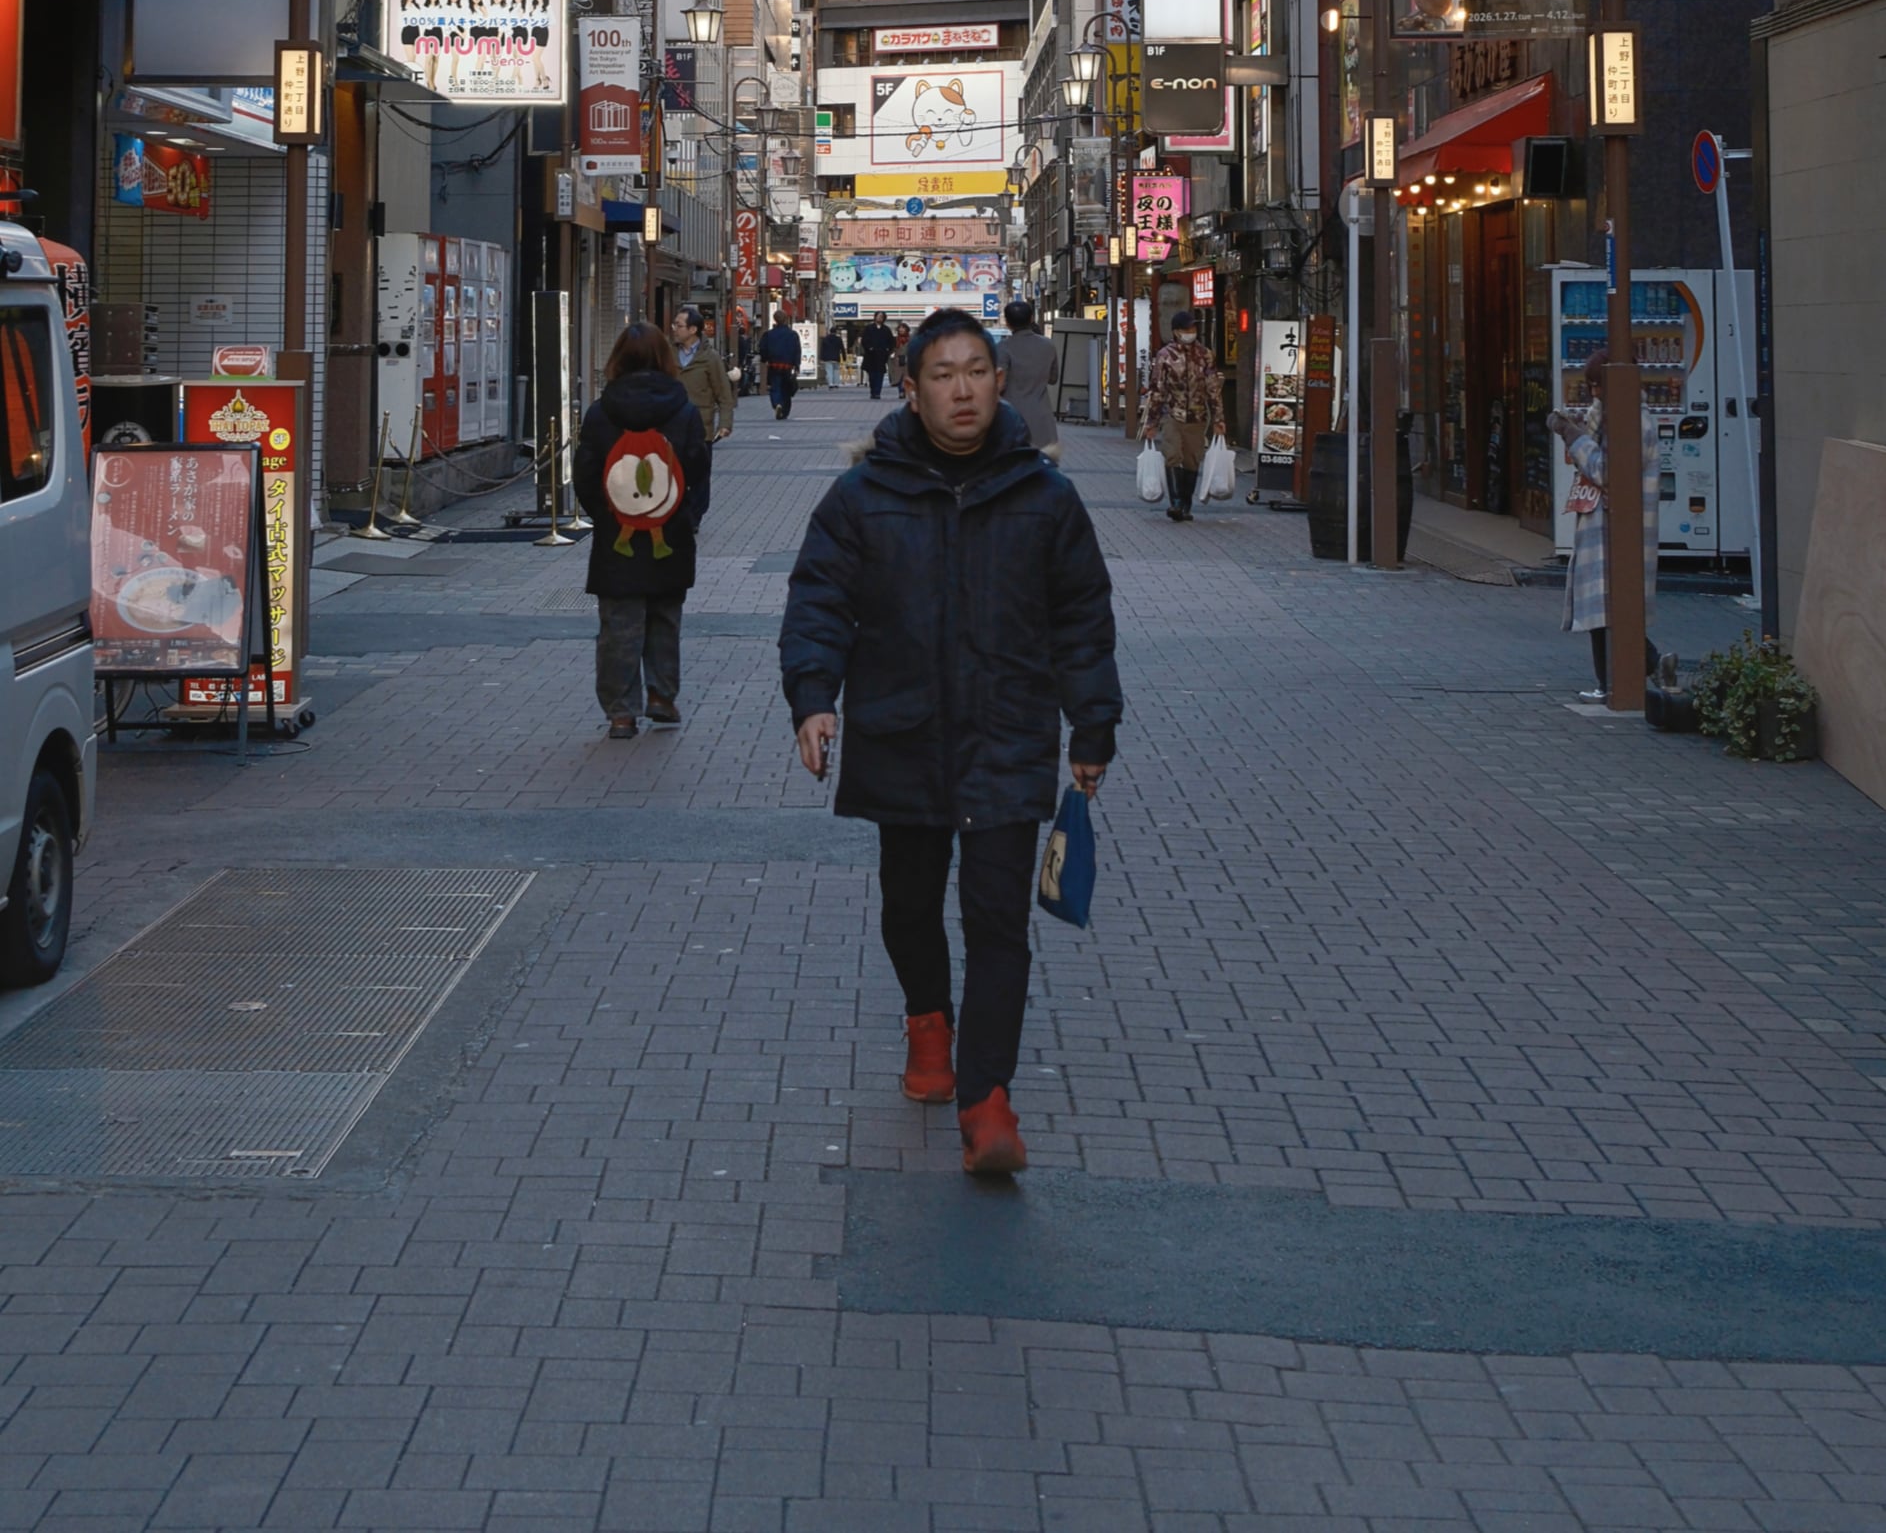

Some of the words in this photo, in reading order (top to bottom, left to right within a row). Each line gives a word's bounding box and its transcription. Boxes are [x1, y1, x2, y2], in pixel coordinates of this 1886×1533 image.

[889, 32, 932, 45] カラオケ
[940, 28, 992, 46] まねきねこ
[1147, 46, 1166, 57] B1F
[1619, 36, 1631, 104] 上野二丁目
[876, 82, 894, 97] 5F
[1607, 65, 1618, 118] 仲町通り
[1136, 195, 1173, 212] 夜の
[873, 225, 957, 244] 仲町通り
[208, 418, 236, 432] THAI
[237, 418, 270, 432] TOPAZ
[262, 454, 288, 470] age
[181, 455, 200, 523] あさが家の
[266, 477, 289, 668] タイ古式マッサージ
